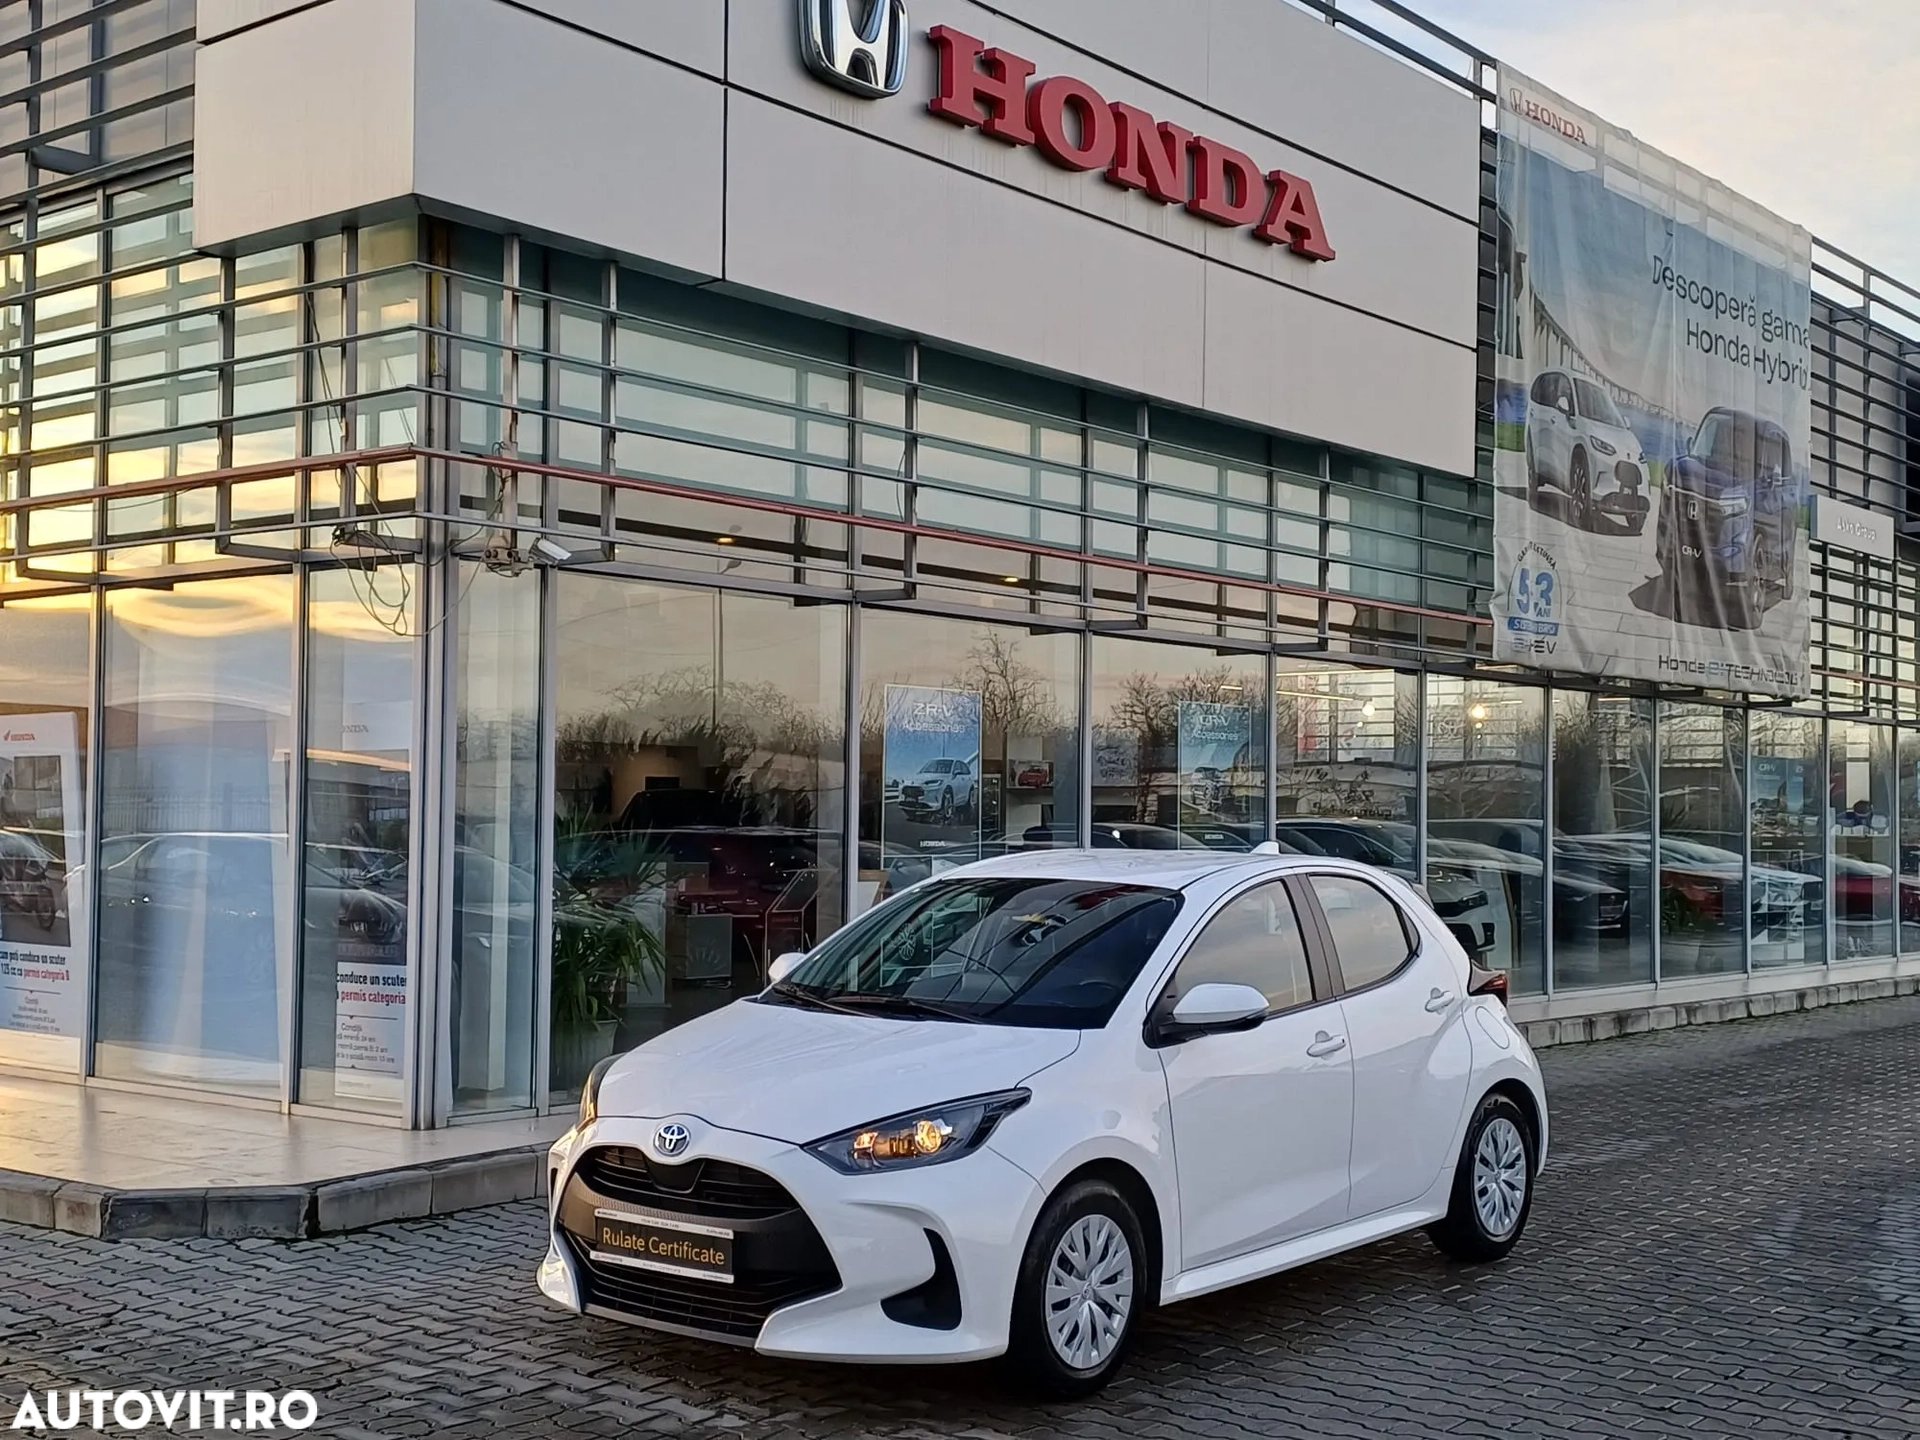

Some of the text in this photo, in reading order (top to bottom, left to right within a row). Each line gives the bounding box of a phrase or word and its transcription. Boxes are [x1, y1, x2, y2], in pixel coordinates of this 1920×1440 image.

[1524, 99, 1588, 147] HONDA
[929, 24, 1336, 263] HONDA
[1652, 255, 1810, 349] Descoperă gama
[1686, 318, 1751, 368] Honda
[1659, 655, 1705, 674] Honda
[913, 702, 953, 716] ZR-V
[341, 989, 406, 1006] permis categoria
[369, 976, 380, 986] un
[602, 1227, 725, 1266] Rulate Certificate
